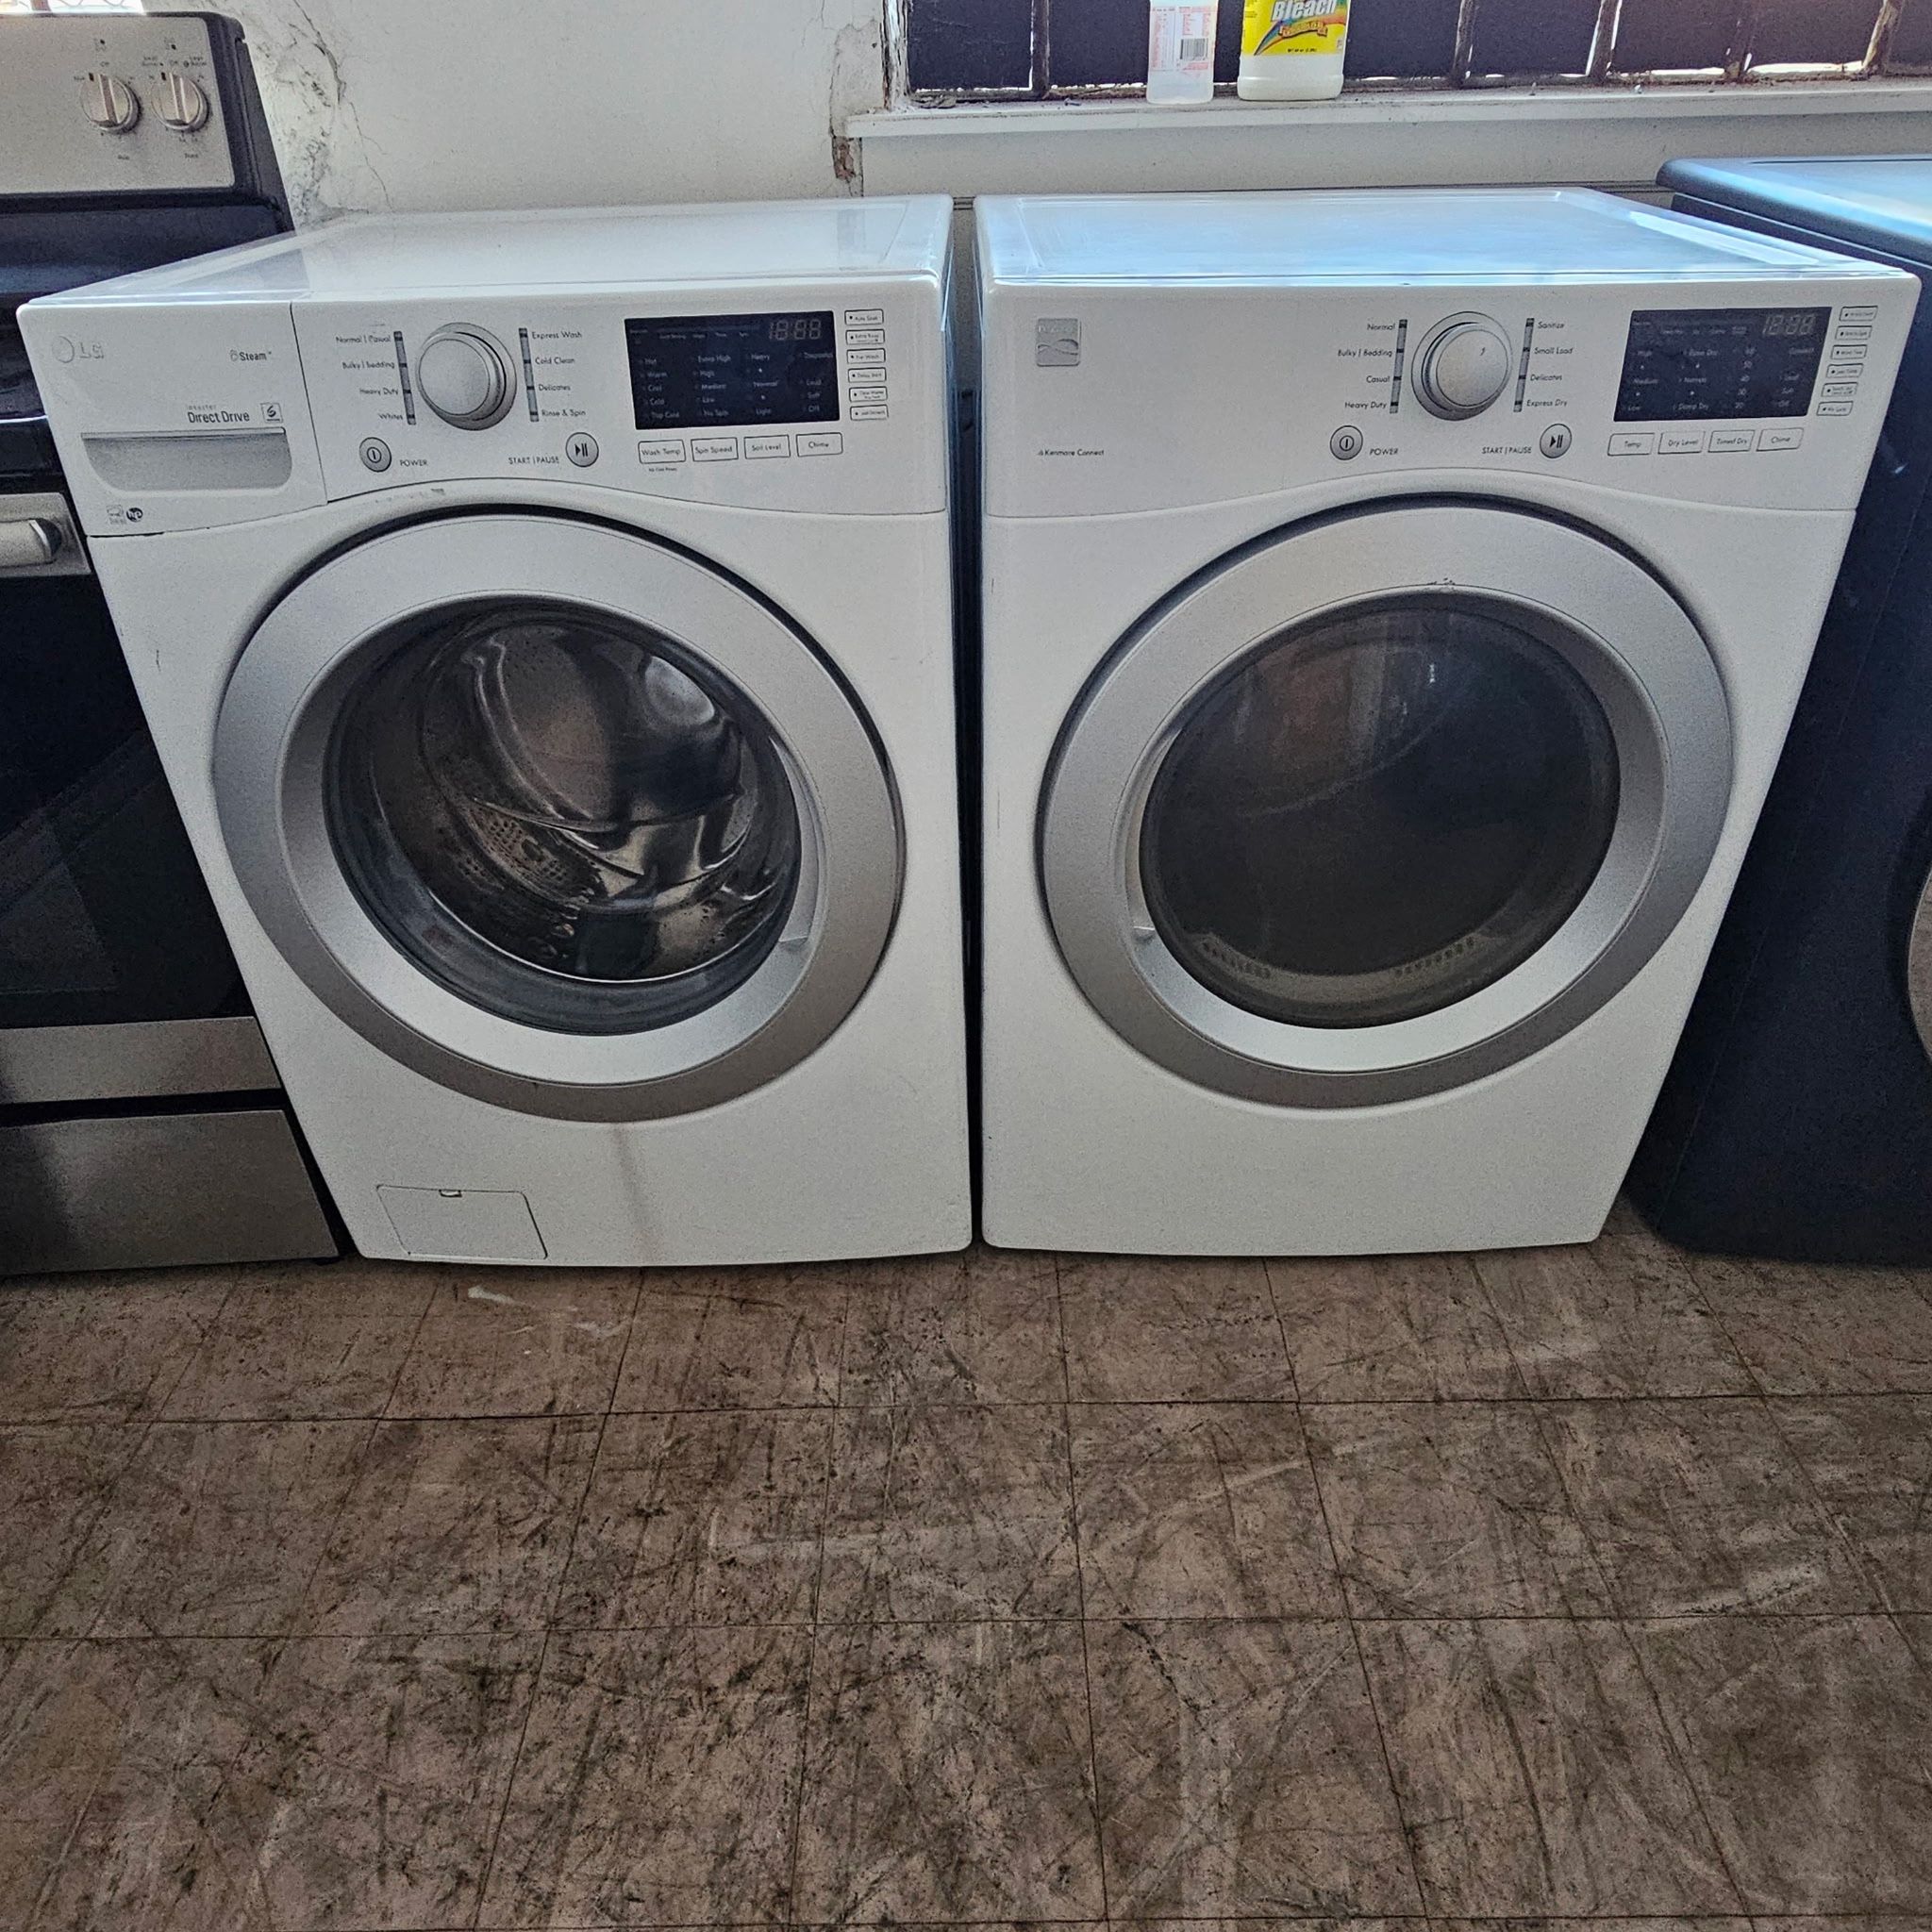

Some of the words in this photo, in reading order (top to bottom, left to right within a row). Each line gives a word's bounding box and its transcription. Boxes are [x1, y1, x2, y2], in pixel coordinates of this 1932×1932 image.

[1272, 0, 1337, 21] Bleach
[239, 352, 267, 361] Steam
[1338, 349, 1356, 358] Bulky
[1363, 349, 1393, 358] Bedding
[1530, 374, 1562, 382] Delicates
[1370, 401, 1388, 409] Duty
[187, 411, 221, 424] Direct
[221, 410, 250, 424] Drive
[570, 408, 586, 417] Spin
[1624, 441, 1642, 449] Temp
[1668, 439, 1680, 447] Dry
[662, 448, 681, 457] Temp
[694, 446, 708, 456] Spin
[710, 445, 733, 454] Speed
